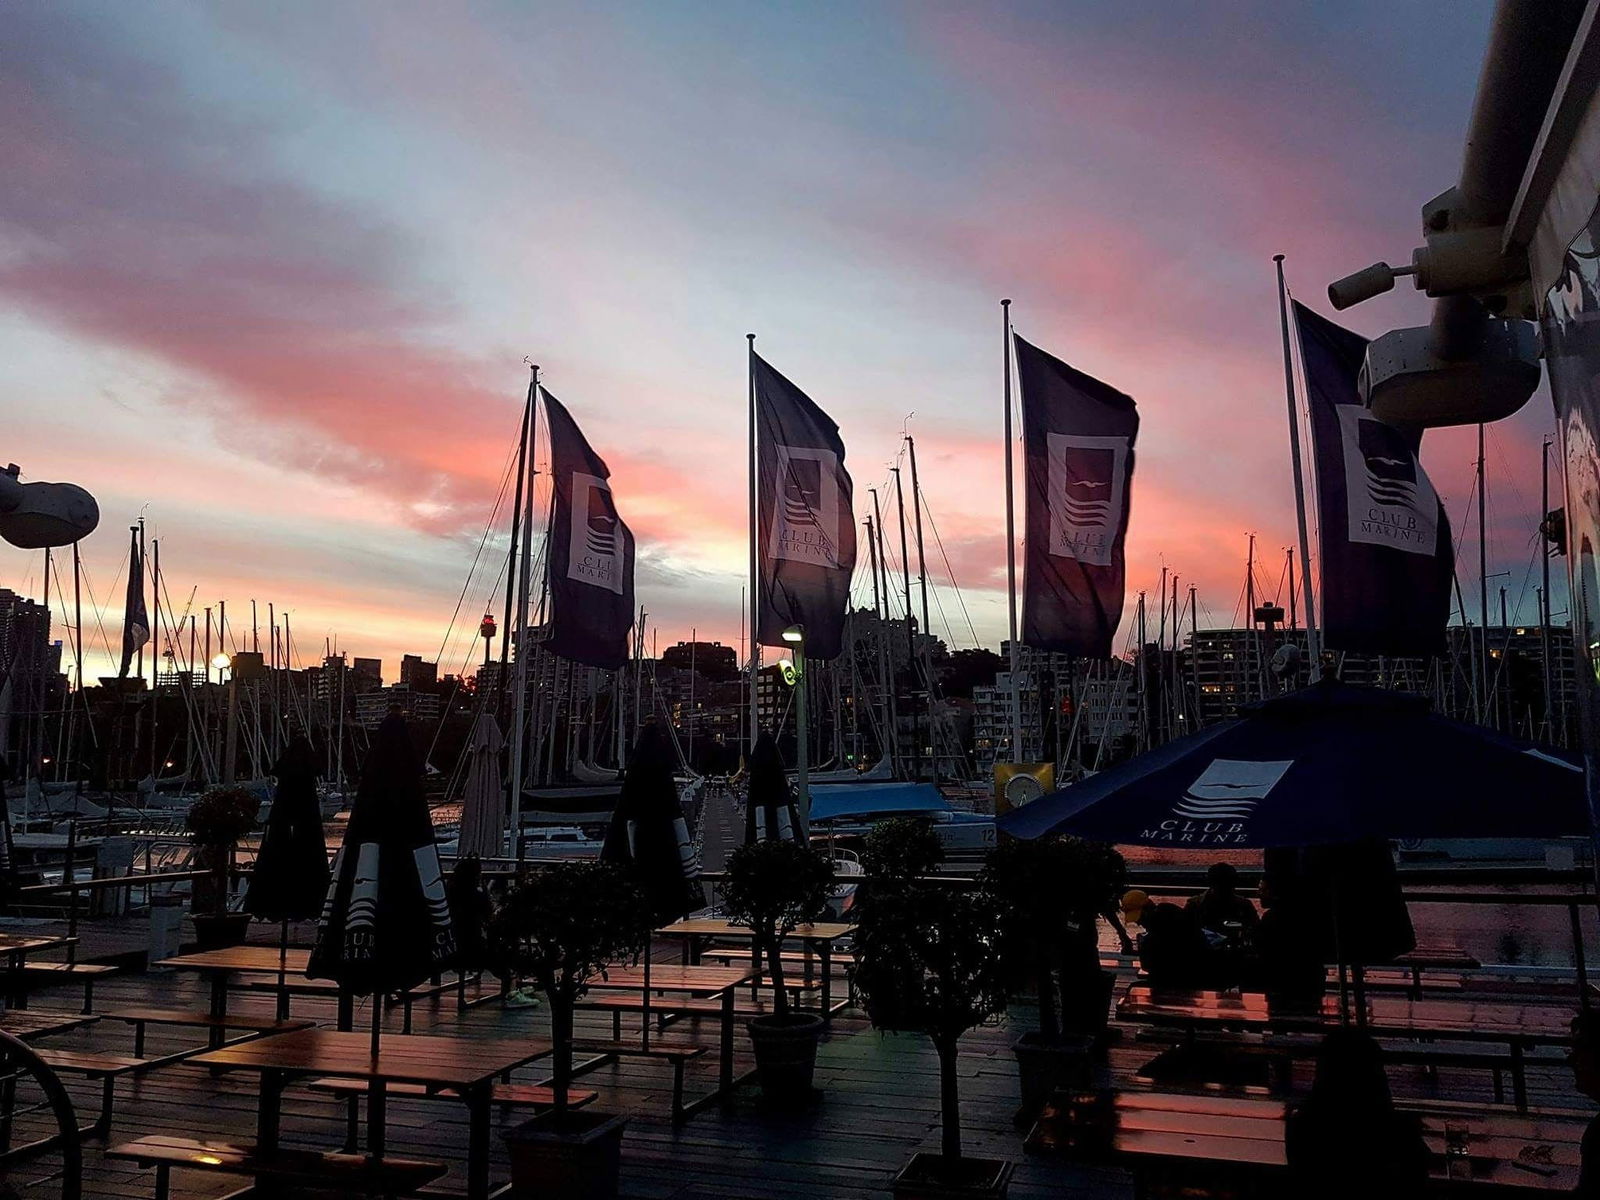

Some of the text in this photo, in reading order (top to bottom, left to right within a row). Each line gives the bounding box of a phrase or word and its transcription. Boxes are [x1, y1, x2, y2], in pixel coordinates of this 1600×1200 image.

[1368, 508, 1417, 529] CLUB
[1160, 820, 1244, 833] CLUB
[982, 829, 995, 841] 12
[1140, 829, 1249, 843] MARINE
